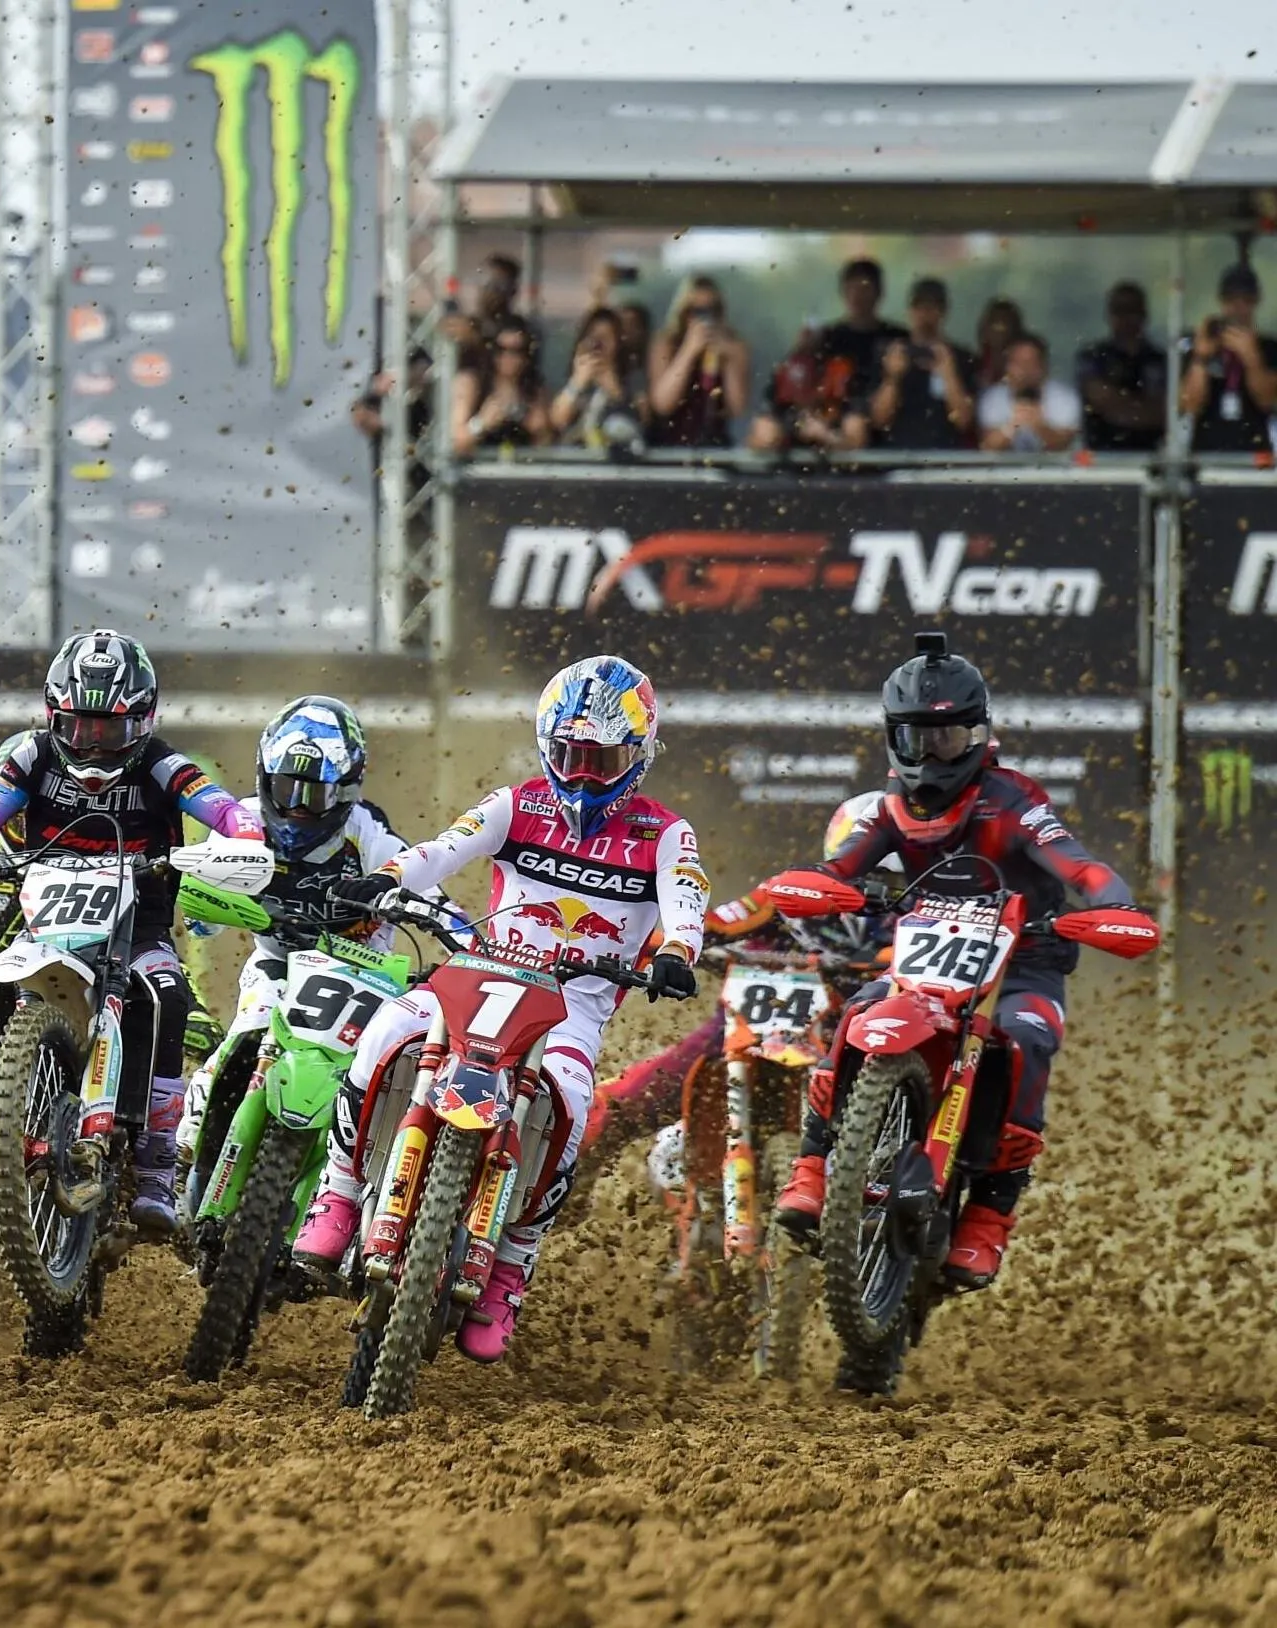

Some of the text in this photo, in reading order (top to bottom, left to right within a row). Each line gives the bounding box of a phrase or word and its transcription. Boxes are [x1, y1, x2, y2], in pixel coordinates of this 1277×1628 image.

[84, 653, 117, 667] Arai
[212, 855, 268, 864] ACERBIS
[516, 851, 647, 895] GASGAS
[30, 883, 119, 928] 259
[180, 884, 231, 911] ACERBIS
[465, 957, 518, 978] MOTOREX
[898, 932, 1001, 985] 243
[287, 974, 384, 1042] 91
[466, 981, 528, 1040] 1
[742, 983, 815, 1027] 84
[495, 1168, 518, 1225] MOTOREX
